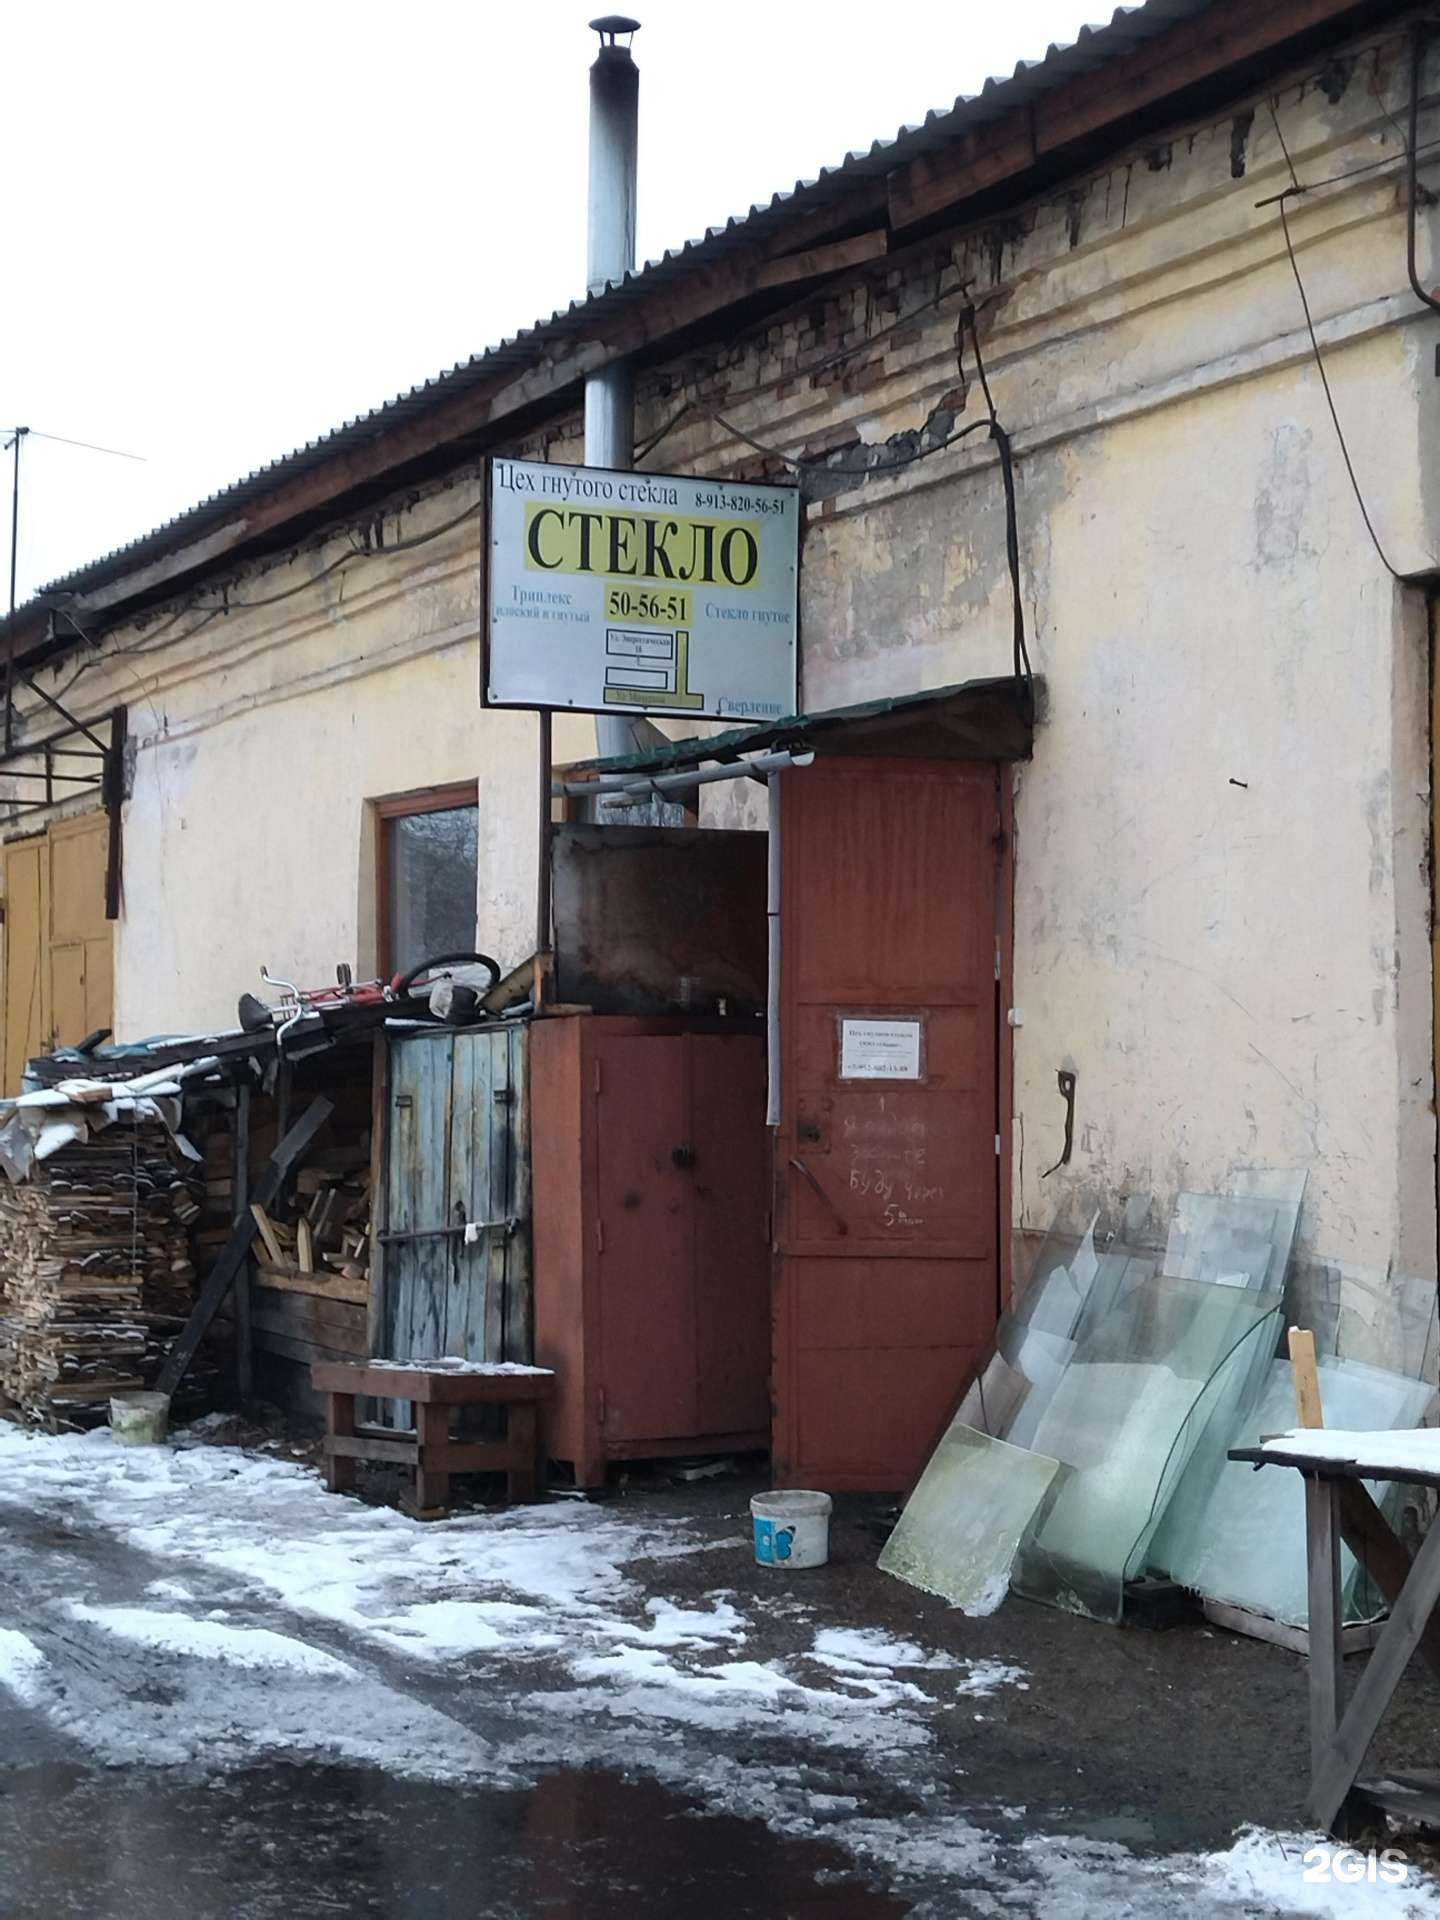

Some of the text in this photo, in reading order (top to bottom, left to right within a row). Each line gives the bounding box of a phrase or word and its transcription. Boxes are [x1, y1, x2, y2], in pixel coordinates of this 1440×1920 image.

[499, 464, 678, 506] Цех гнутого стекла
[695, 491, 786, 515] 8-913-820-56-51
[527, 508, 759, 586] СТЕКЛО
[512, 583, 573, 606] Триплекс
[609, 591, 687, 621] 50-56-51
[705, 602, 749, 621] Стекло
[718, 696, 785, 717] Сверление
